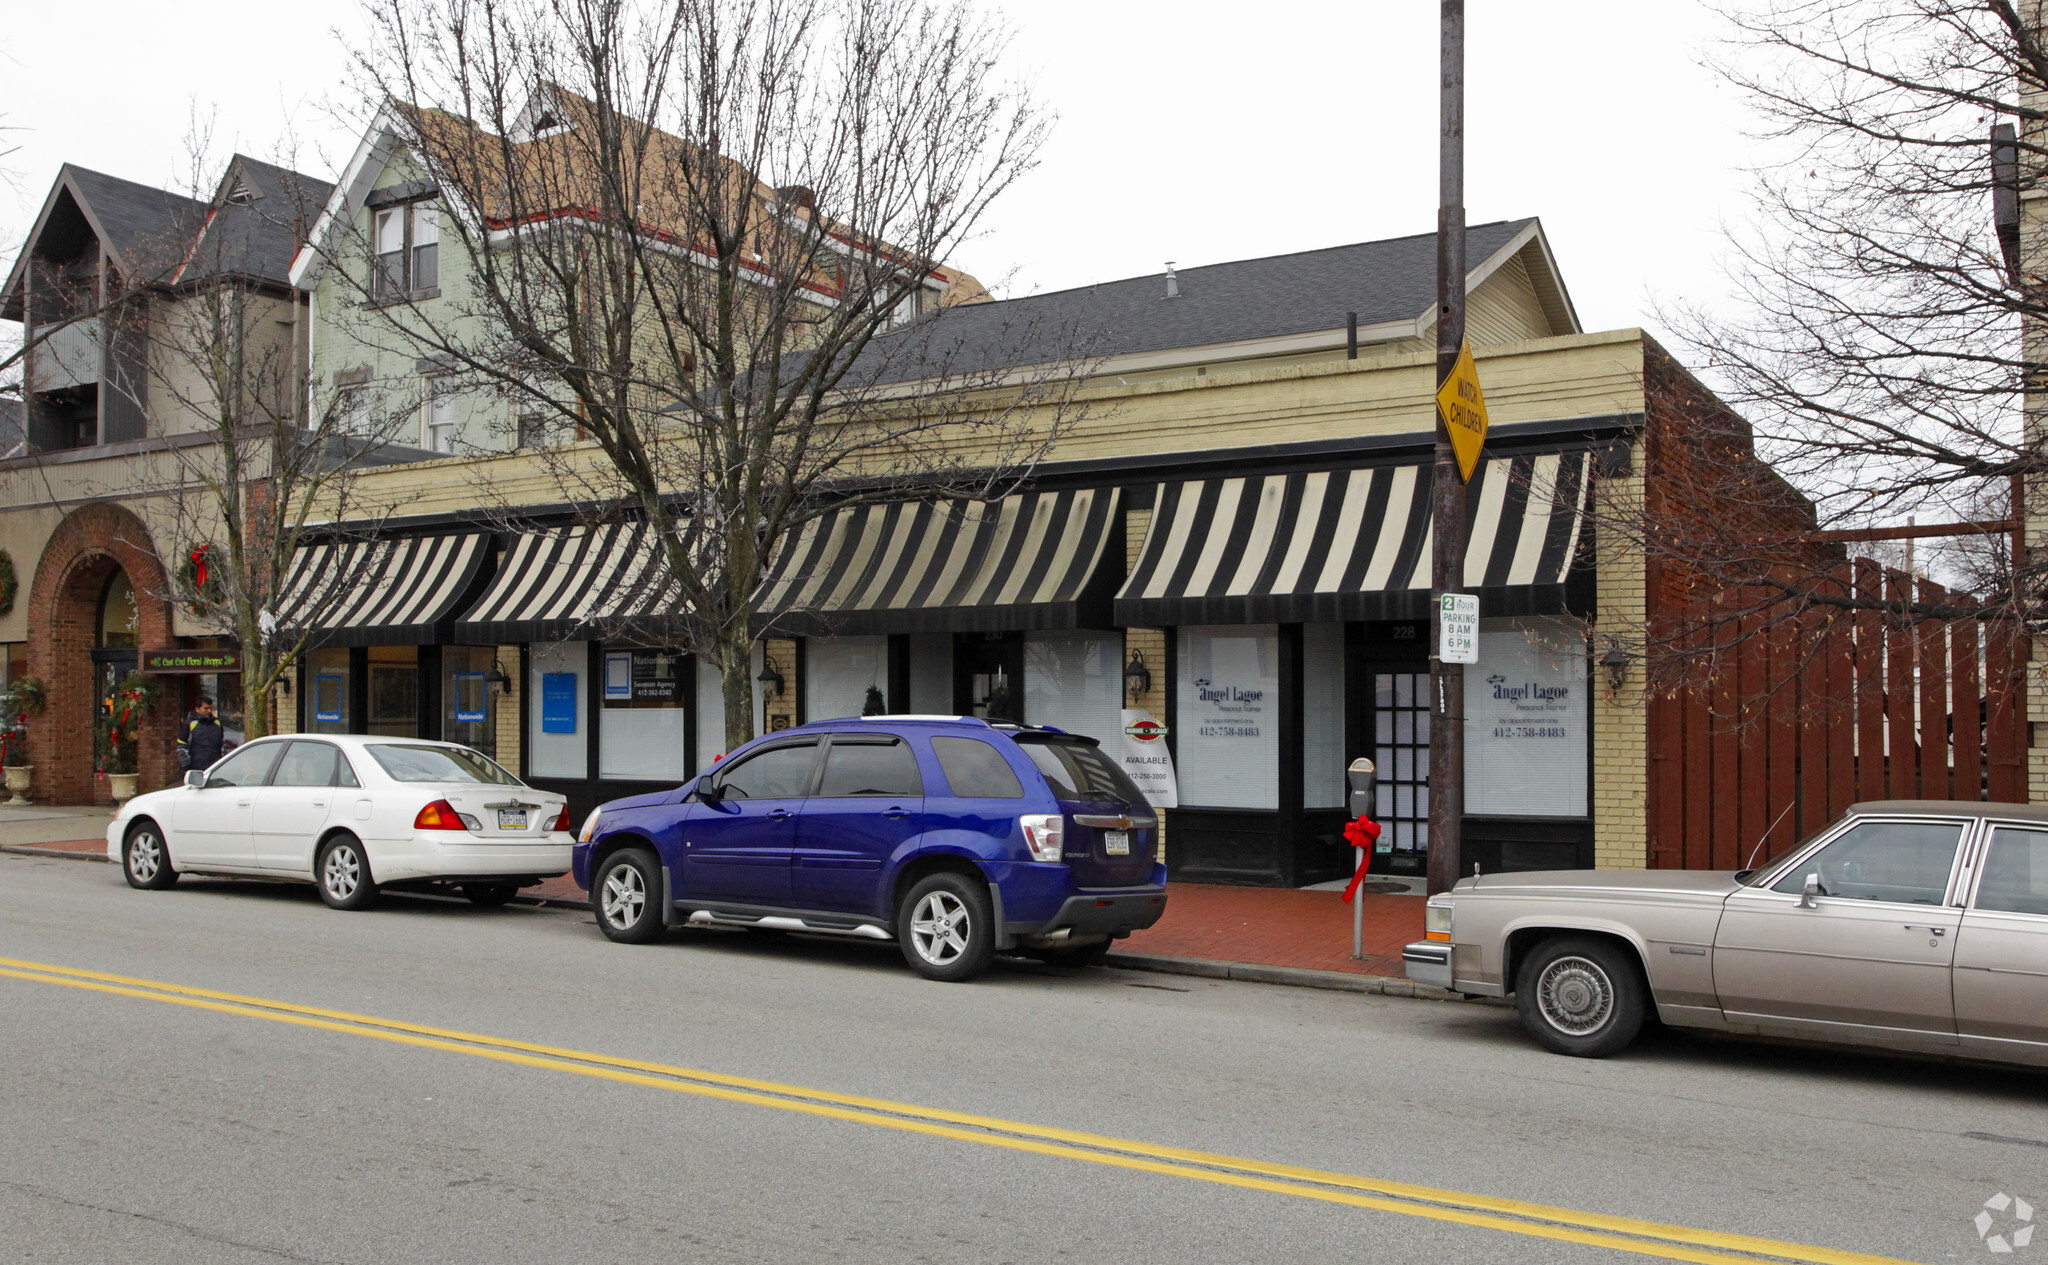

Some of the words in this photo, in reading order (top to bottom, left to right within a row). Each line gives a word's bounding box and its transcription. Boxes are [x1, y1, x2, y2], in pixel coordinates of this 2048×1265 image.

[1457, 376, 1478, 406] WATCH
[1450, 402, 1483, 435] CHILDREN
[1445, 597, 1453, 609] 2
[1457, 601, 1475, 610] HOUR
[1443, 612, 1476, 624] PARKING
[1393, 626, 1415, 639] 228
[1448, 624, 1455, 634] 8
[1457, 624, 1471, 634] AM
[1448, 637, 1455, 648] 6
[1457, 638, 1471, 649] PM
[633, 656, 676, 664] Nationwide
[656, 681, 676, 689] Agency
[1199, 686, 1229, 705] angel
[1233, 686, 1263, 705] Lagoe
[1493, 683, 1528, 703] angel
[1533, 683, 1568, 703] Lagoe
[1199, 726, 1260, 736] 412-758-8483
[1493, 727, 1566, 737] 412-758-8483
